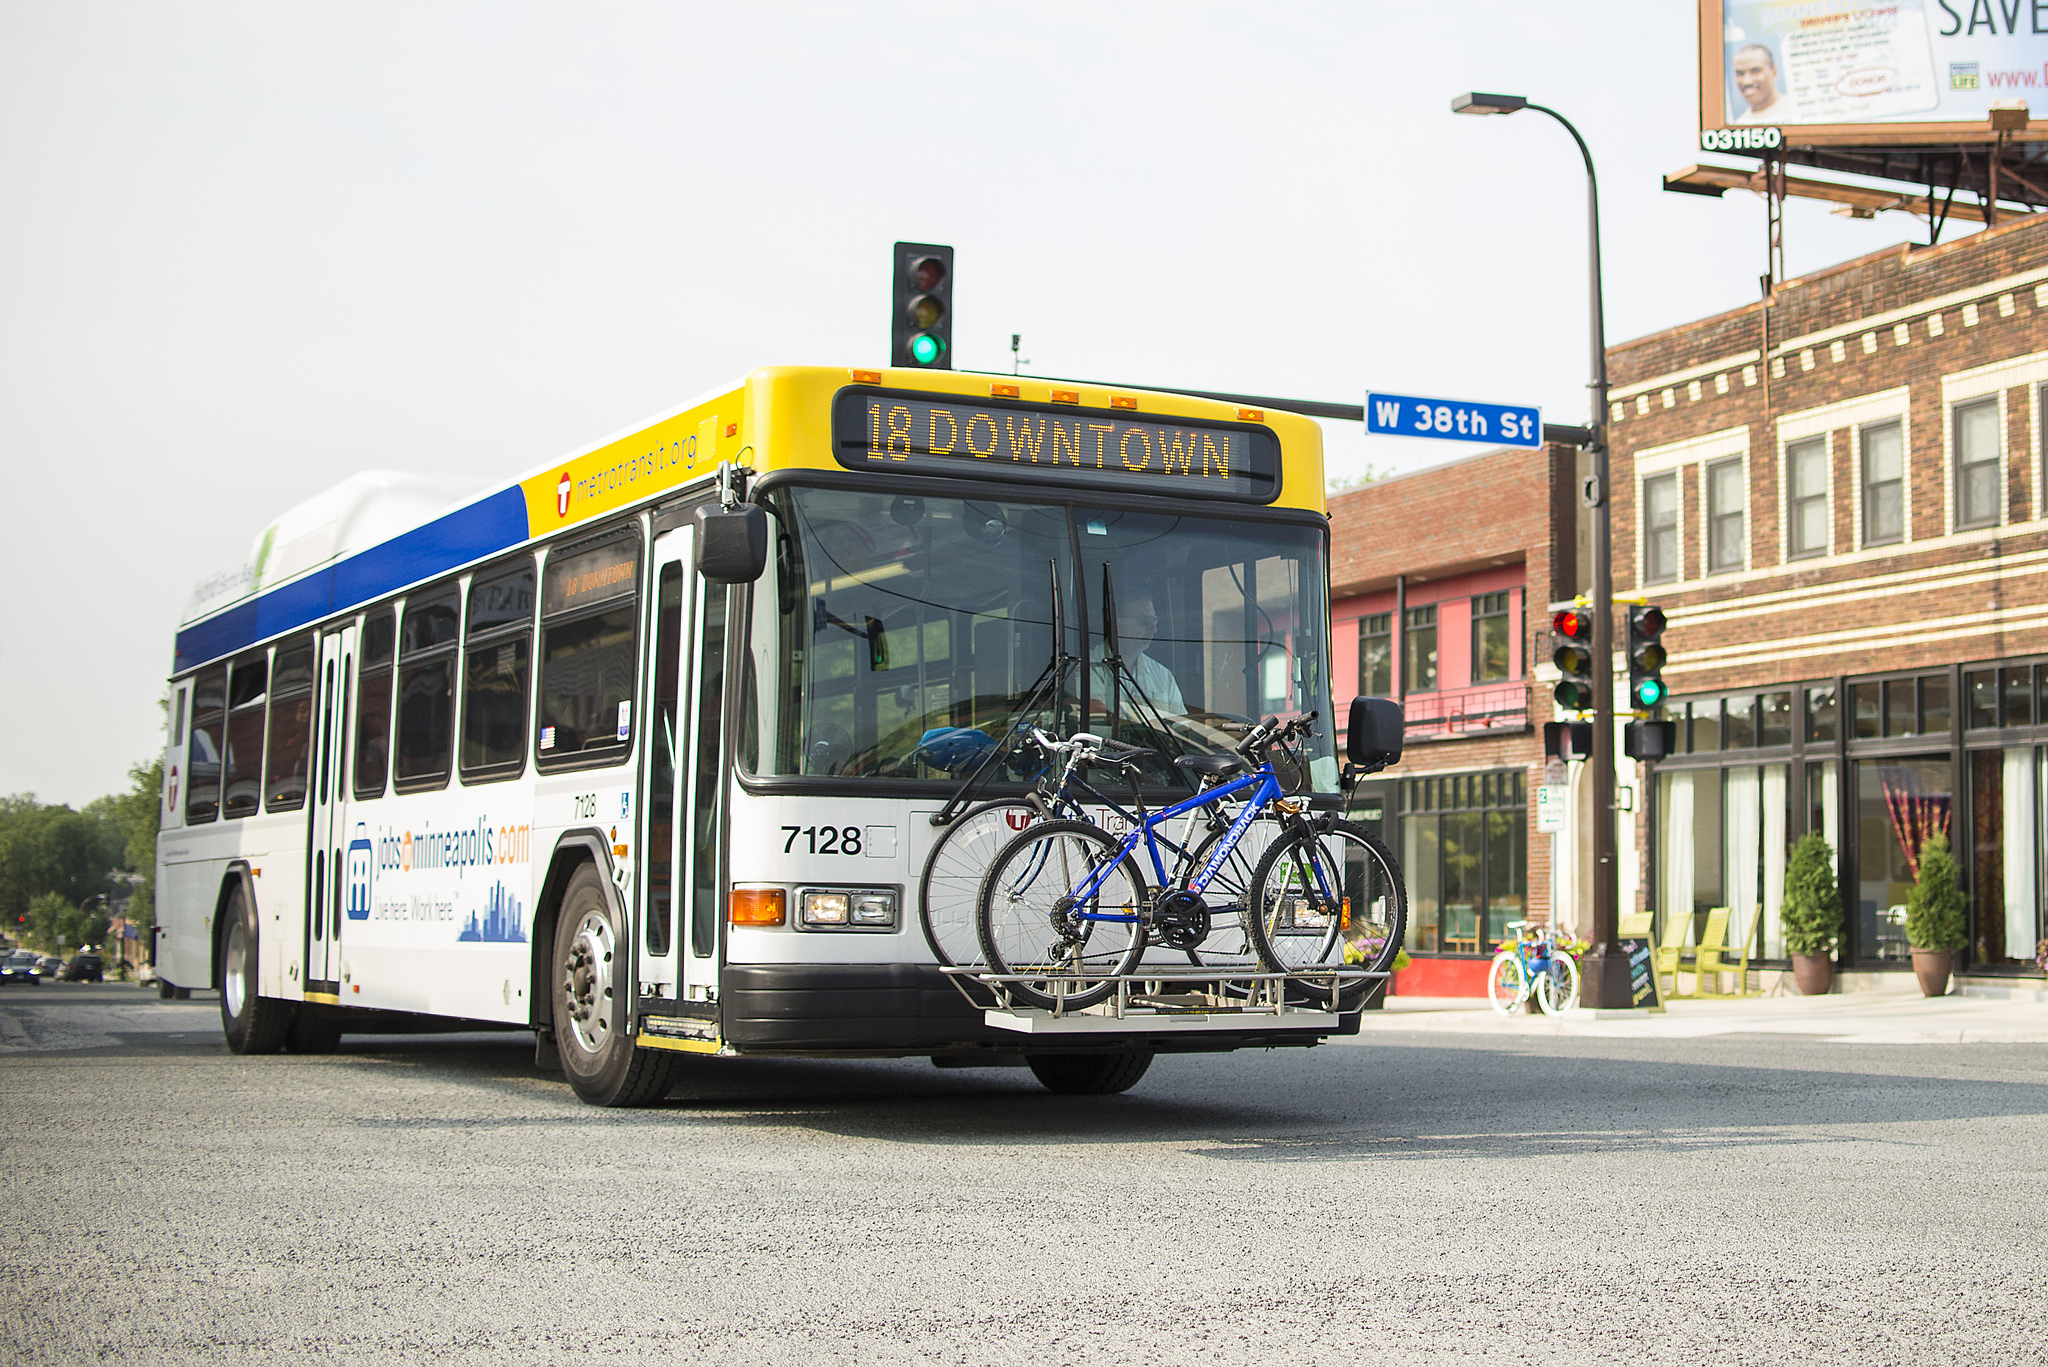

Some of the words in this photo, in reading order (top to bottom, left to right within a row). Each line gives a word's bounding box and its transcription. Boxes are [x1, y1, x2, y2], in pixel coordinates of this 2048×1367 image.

[1702, 127, 1781, 150] 031150
[1376, 401, 1400, 428] W
[1414, 404, 1488, 436] 38th
[1501, 412, 1533, 440] St
[867, 404, 911, 462] 18
[928, 408, 1230, 480] DOWNTOWN
[576, 435, 697, 503] metrotransit.org
[574, 793, 597, 819] 7128
[780, 826, 863, 856] 7128
